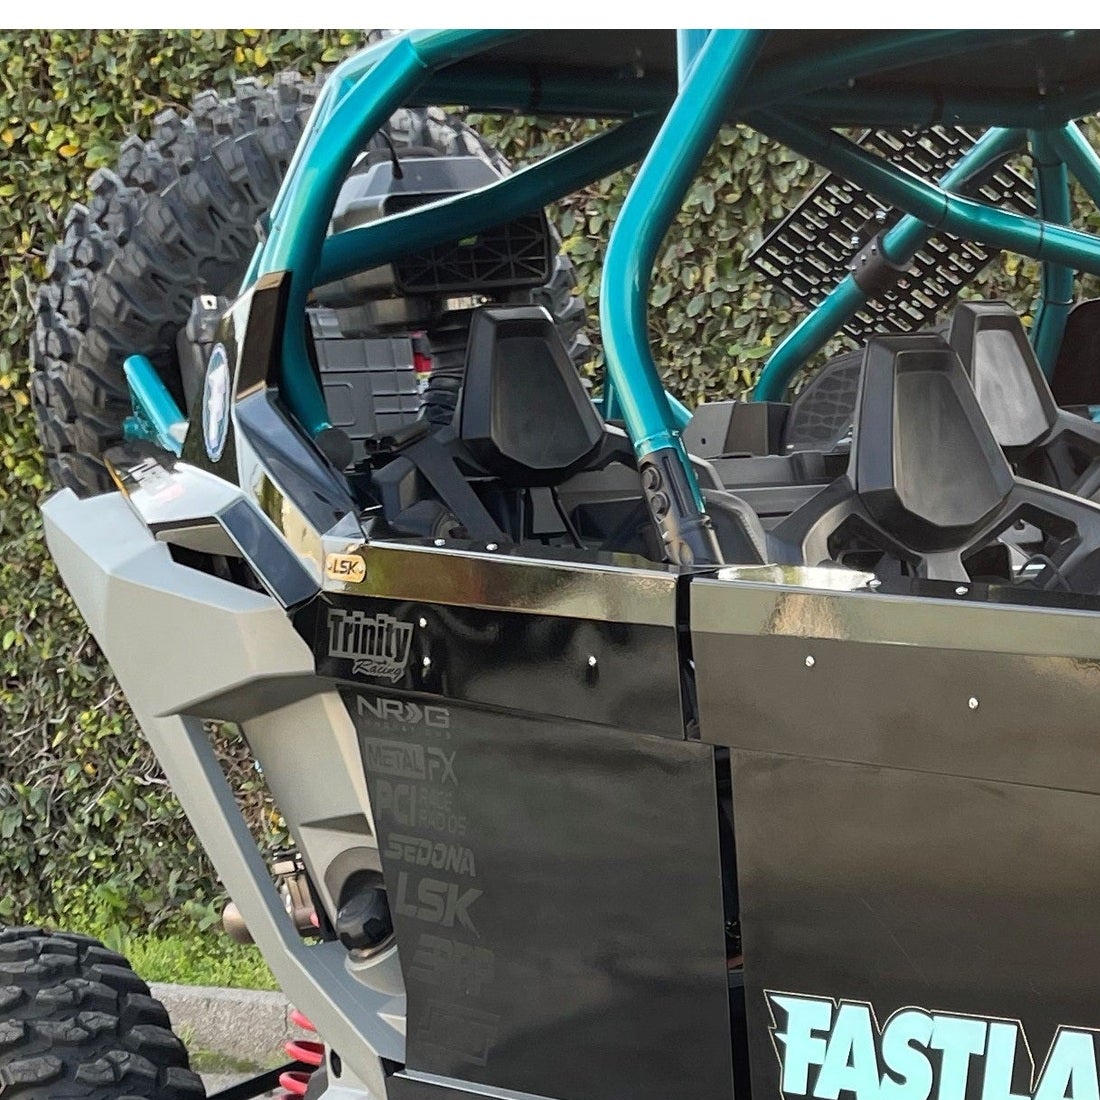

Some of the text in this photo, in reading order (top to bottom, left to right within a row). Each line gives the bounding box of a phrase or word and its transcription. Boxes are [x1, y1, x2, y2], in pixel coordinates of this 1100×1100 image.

[332, 558, 359, 575] LSK
[328, 609, 414, 666] Trinity
[352, 658, 405, 683] Racing
[383, 832, 476, 877] SEDONA
[394, 871, 484, 938] LSK
